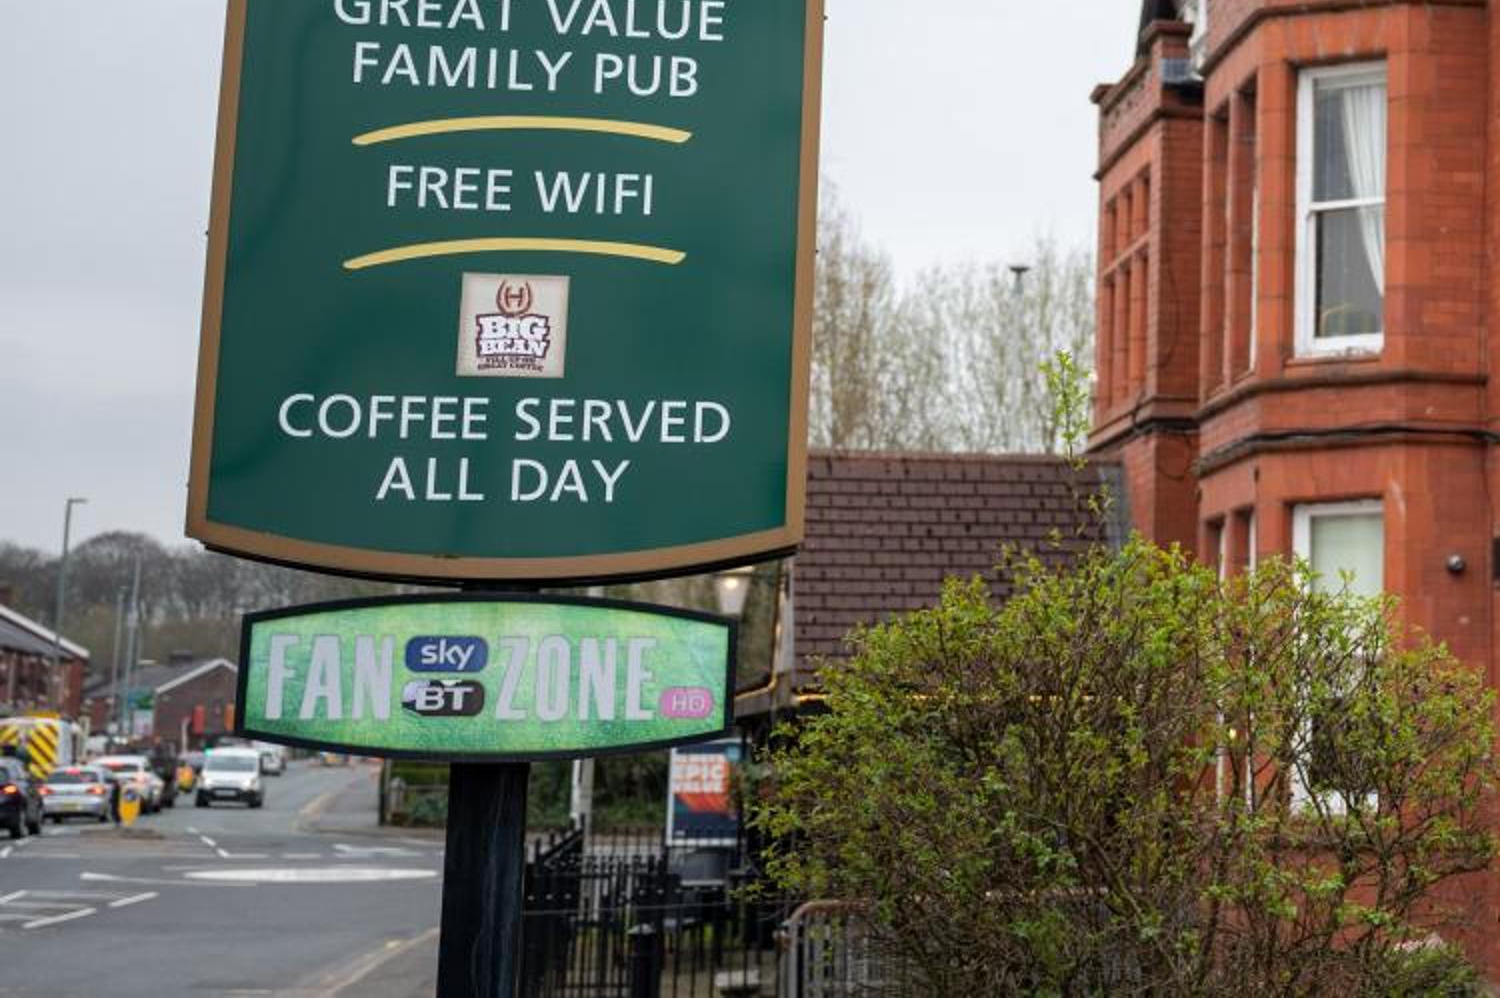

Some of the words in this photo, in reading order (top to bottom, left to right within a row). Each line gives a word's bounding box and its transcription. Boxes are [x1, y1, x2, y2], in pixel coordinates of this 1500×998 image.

[352, 41, 572, 92] FAMILY
[594, 54, 699, 97] PUB
[386, 165, 513, 211] FREE
[534, 170, 653, 215] WIFI
[479, 316, 547, 341] BIG
[479, 339, 547, 357] BEAN
[278, 393, 490, 440] COFFEE
[514, 397, 731, 443] SERVED
[375, 457, 485, 501] ALL
[510, 458, 631, 502] DAY
[421, 639, 475, 671] sky
[264, 634, 396, 722] FAN
[495, 635, 657, 723] ZONE
[416, 686, 475, 711] BT
[672, 693, 705, 712] HD
